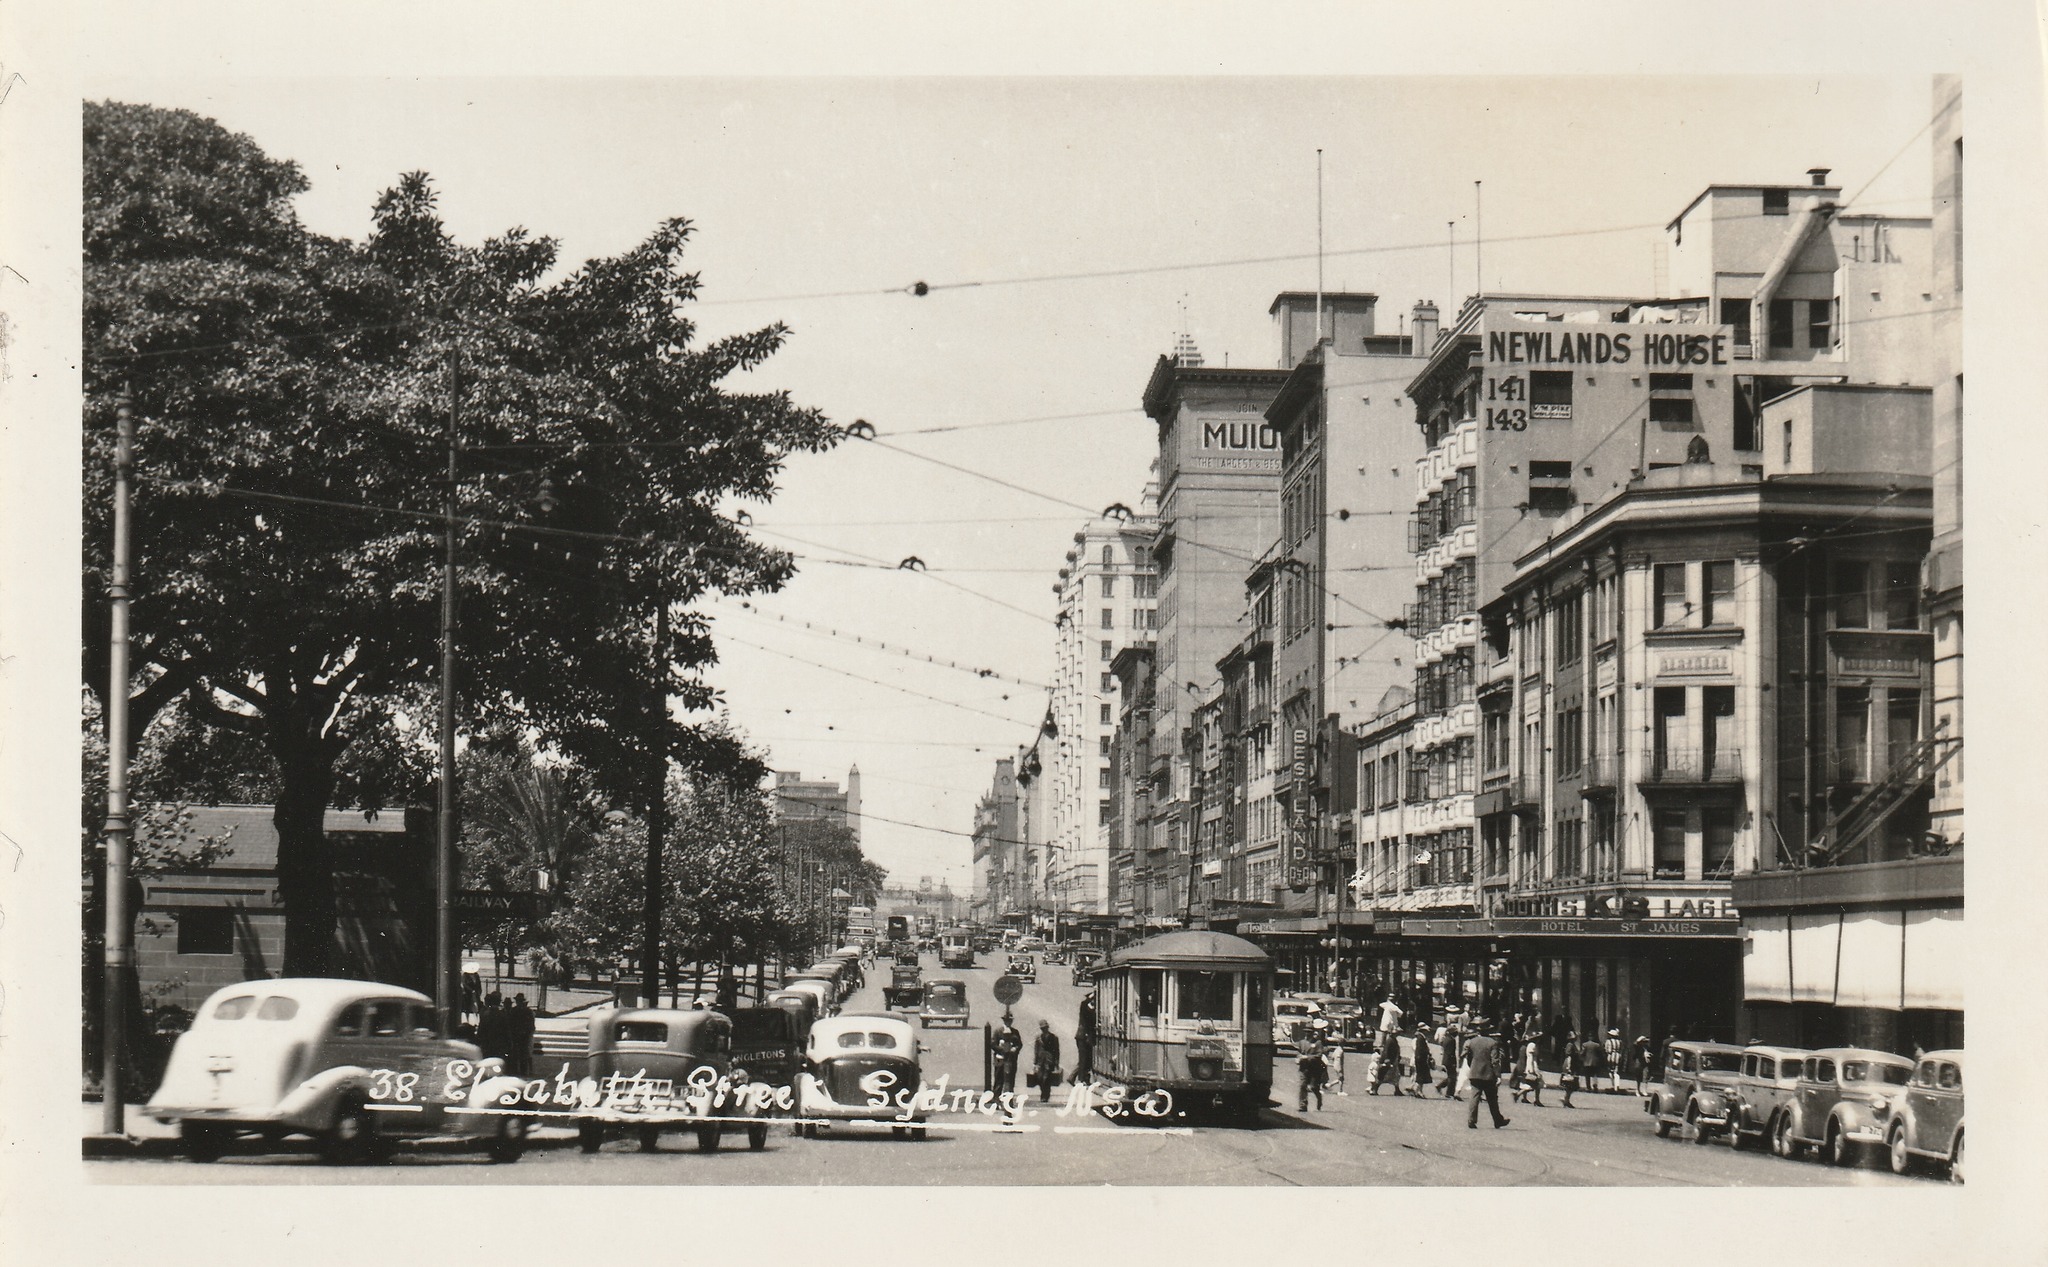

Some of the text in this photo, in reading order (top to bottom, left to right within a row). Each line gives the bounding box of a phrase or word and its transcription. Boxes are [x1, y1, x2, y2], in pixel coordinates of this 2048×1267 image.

[1490, 331, 1728, 365] NEWLANDS HOUSE
[1488, 377, 1526, 402] 141
[1486, 408, 1528, 432] 143
[1203, 422, 1282, 451] MUIO
[1264, 459, 1281, 470] BES
[1664, 899, 1737, 917] LAGE
[1540, 921, 1584, 932] HOTEL
[1648, 922, 1700, 933] JAMES
[736, 1049, 786, 1061] NGLETONS
